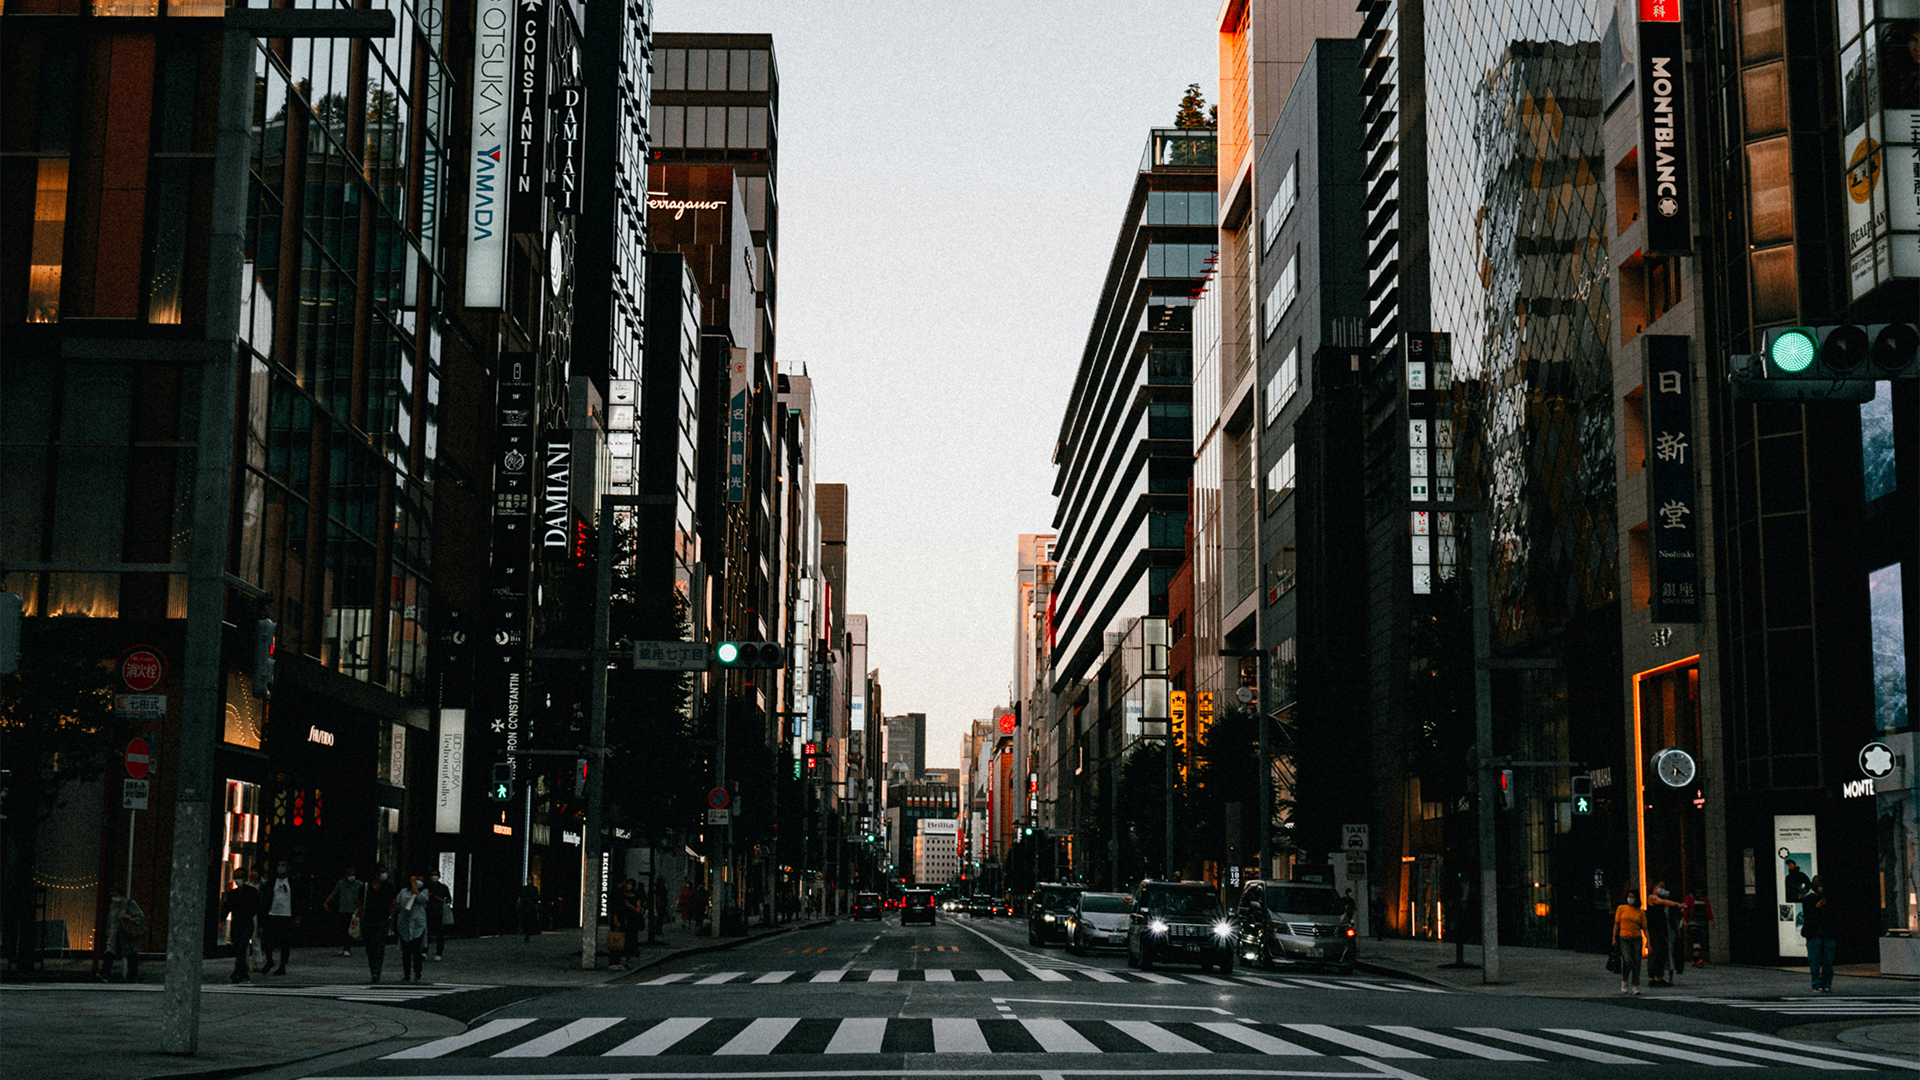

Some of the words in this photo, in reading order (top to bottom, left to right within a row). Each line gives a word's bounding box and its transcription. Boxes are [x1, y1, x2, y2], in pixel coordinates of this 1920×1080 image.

[479, 8, 507, 115] OTSUKA
[518, 19, 537, 193] CONSTANTIN
[561, 90, 580, 208] DAMIANI
[1651, 57, 1677, 196] MONTBLANC
[474, 145, 501, 241] YAMADA
[730, 408, 744, 489] 名鉄観光
[1656, 370, 1690, 530] 日新堂
[543, 441, 571, 548] DAMIANI
[126, 663, 158, 679] 消火栓
[639, 648, 703, 660] 銀座七丁目
[130, 699, 160, 710] 七田式
[507, 672, 520, 730] CONSTANTIN
[602, 852, 610, 892] EXCELSIOR
[1345, 826, 1366, 834] TAXI
